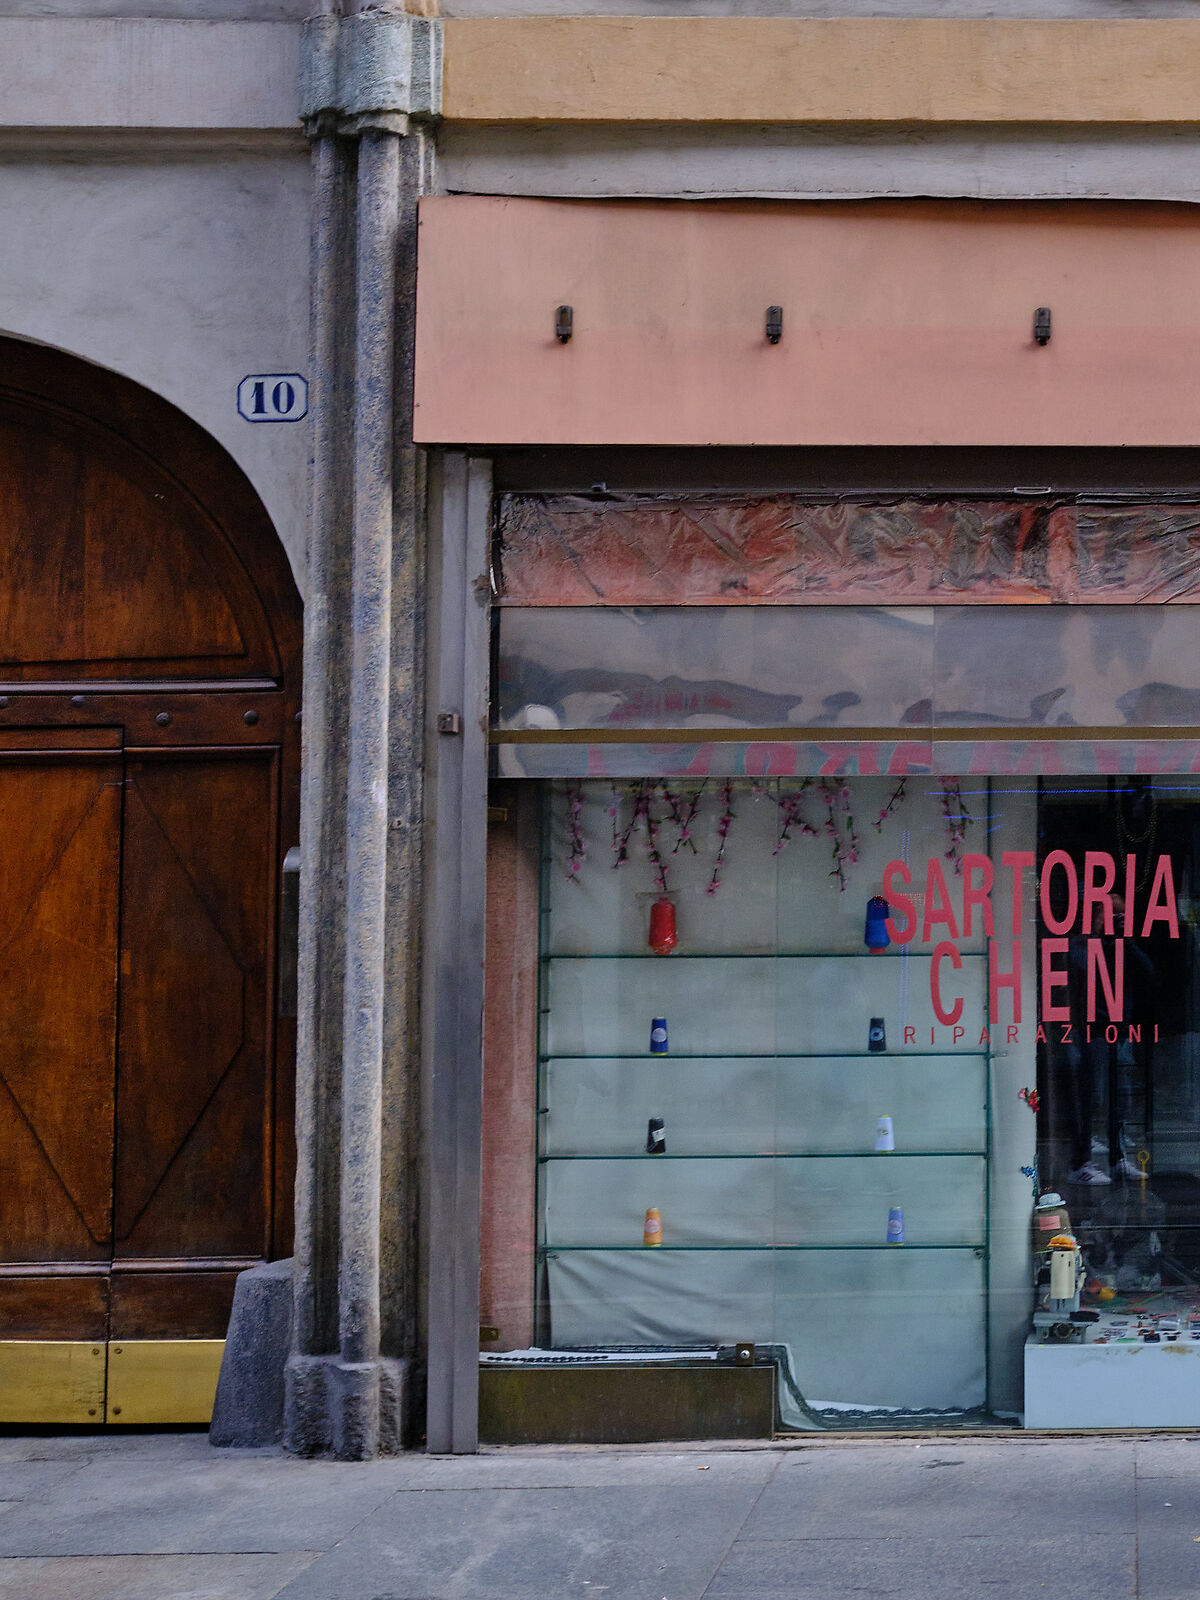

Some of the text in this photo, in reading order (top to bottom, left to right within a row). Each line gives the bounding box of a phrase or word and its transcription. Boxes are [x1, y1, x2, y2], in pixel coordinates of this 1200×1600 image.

[251, 381, 295, 414] 10
[882, 849, 1180, 944] SARTORIA
[930, 937, 1124, 1026] CHEN
[904, 1024, 1160, 1045] RIPARAZIONI
